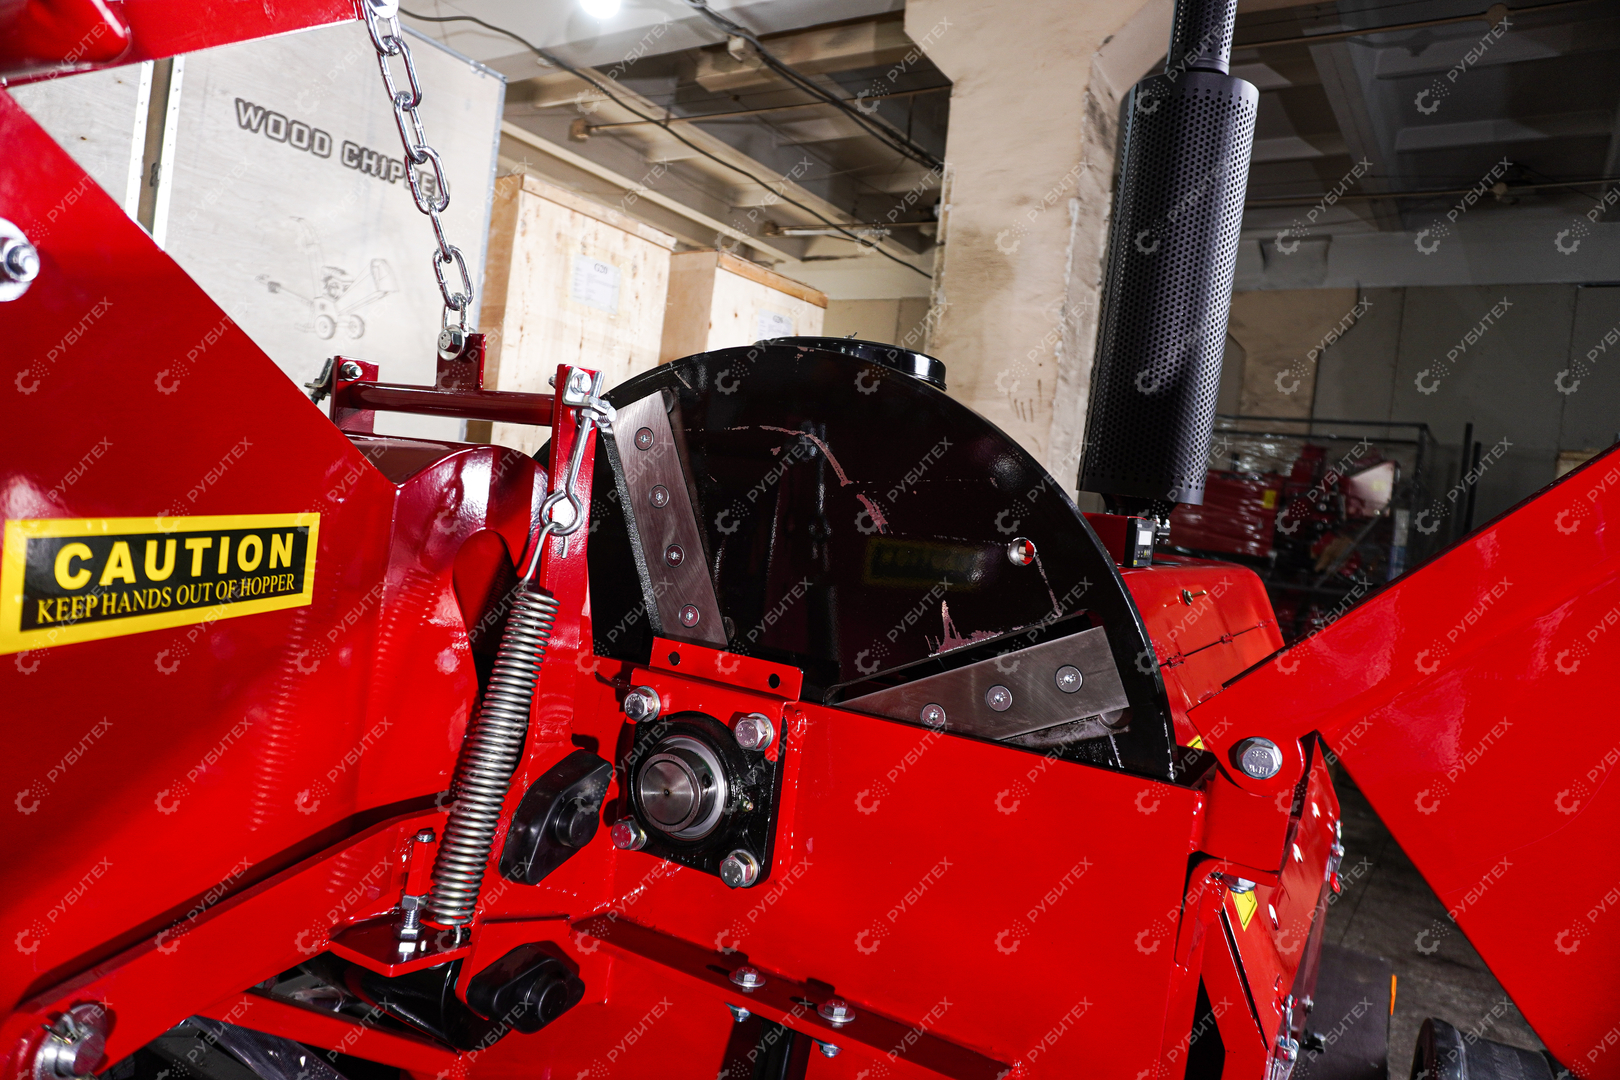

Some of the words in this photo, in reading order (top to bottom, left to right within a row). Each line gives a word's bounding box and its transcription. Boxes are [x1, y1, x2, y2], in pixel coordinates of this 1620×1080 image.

[235, 97, 332, 159] WOOD
[53, 532, 294, 590] CAUTION
[37, 596, 99, 624] KEEP
[100, 586, 172, 616] HANDS
[176, 582, 213, 606] OUT
[215, 579, 237, 601] OF
[240, 573, 295, 597] HOPPER
